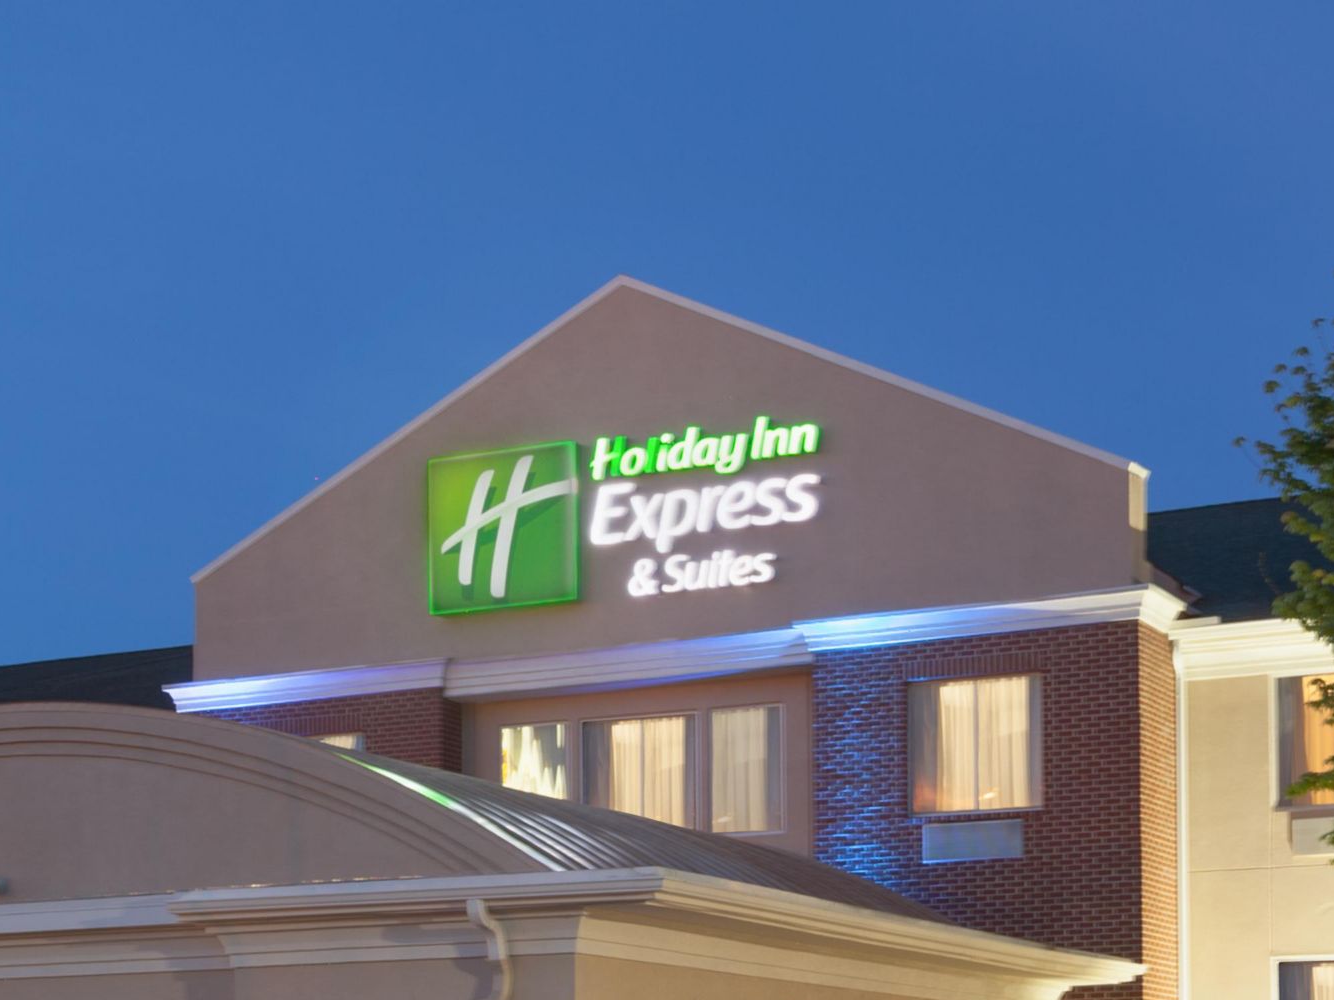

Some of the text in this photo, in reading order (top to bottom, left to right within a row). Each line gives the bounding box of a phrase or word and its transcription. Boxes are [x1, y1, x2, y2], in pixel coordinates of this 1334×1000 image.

[590, 416, 821, 481] Holiday Inn
[441, 455, 579, 598] H
[589, 473, 822, 553] Express
[627, 550, 777, 597] & Suites
